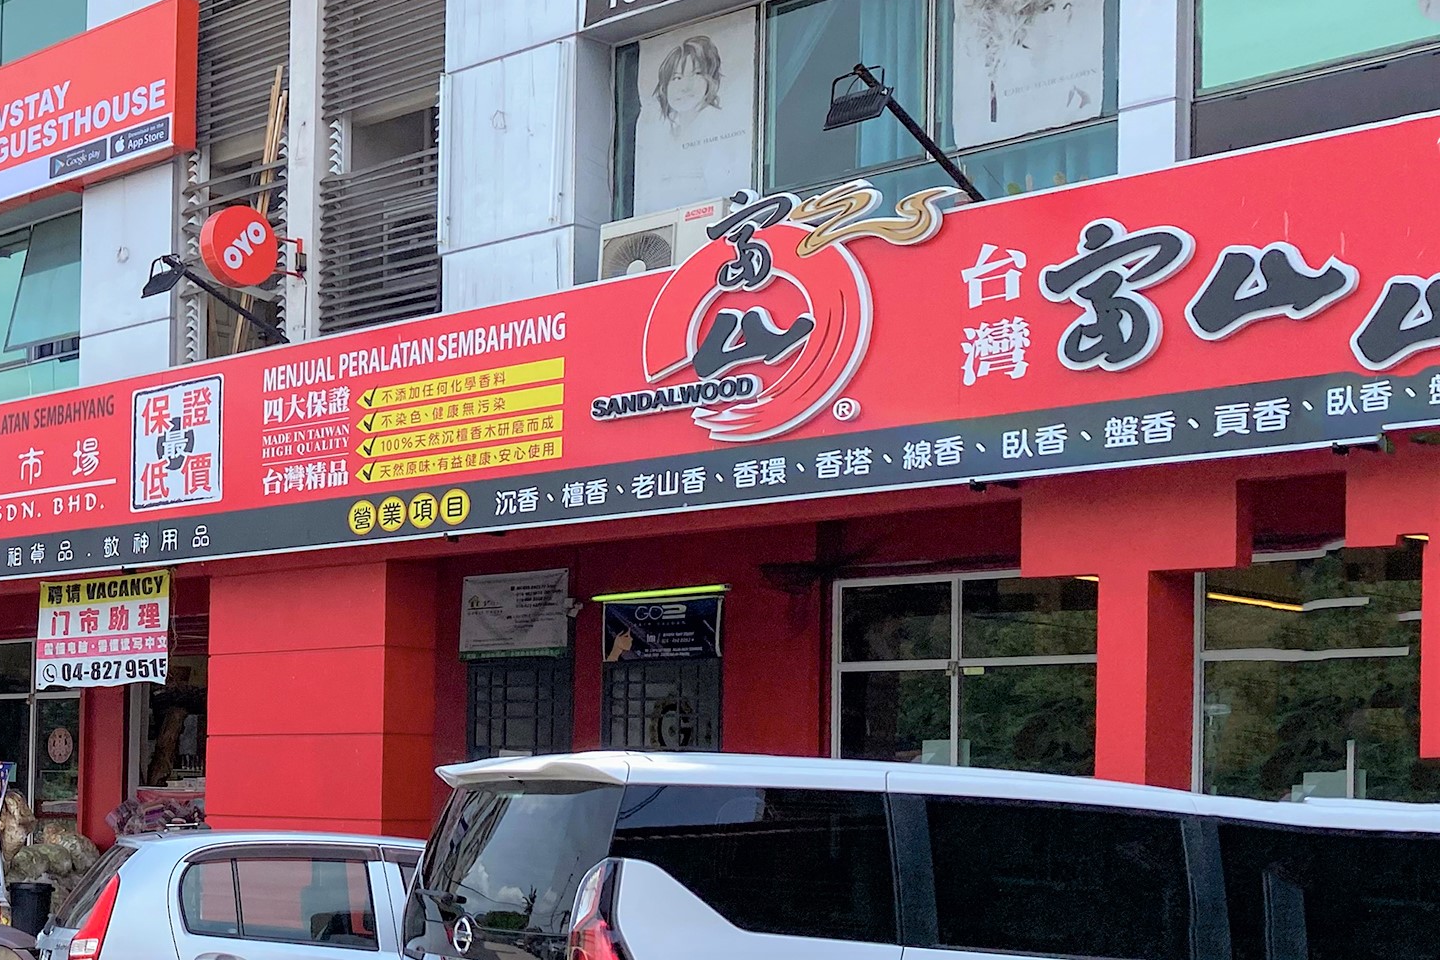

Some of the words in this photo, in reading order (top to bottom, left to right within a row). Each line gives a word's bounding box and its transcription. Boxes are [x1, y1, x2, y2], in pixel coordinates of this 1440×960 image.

[88, 149, 101, 161] play
[128, 139, 143, 150] App
[144, 130, 164, 144] Store
[223, 220, 267, 270] OYO
[960, 243, 1031, 387] 台灣
[263, 356, 336, 393] MENJUAL
[337, 341, 437, 380] PERALATAN
[438, 311, 567, 363] SEMBAHYANG
[33, 394, 116, 430] SEMBAHYANG
[263, 386, 350, 425] 四大保證
[590, 374, 761, 421] SANDALWOOD
[262, 432, 292, 446] MADE
[293, 430, 306, 442] IN
[307, 423, 350, 440] TAIWAN
[262, 445, 292, 459] HIGH
[296, 437, 350, 456] QUALITY
[262, 459, 349, 496] 台灣精品
[52, 493, 106, 516] BHD.
[349, 494, 464, 530] 營業項目
[48, 583, 81, 604] 聘请
[86, 575, 164, 600] VACANCY
[51, 603, 161, 636] 门市助理
[635, 604, 687, 620] GO2
[62, 660, 122, 681] 04-827
[125, 658, 167, 678] 9515
